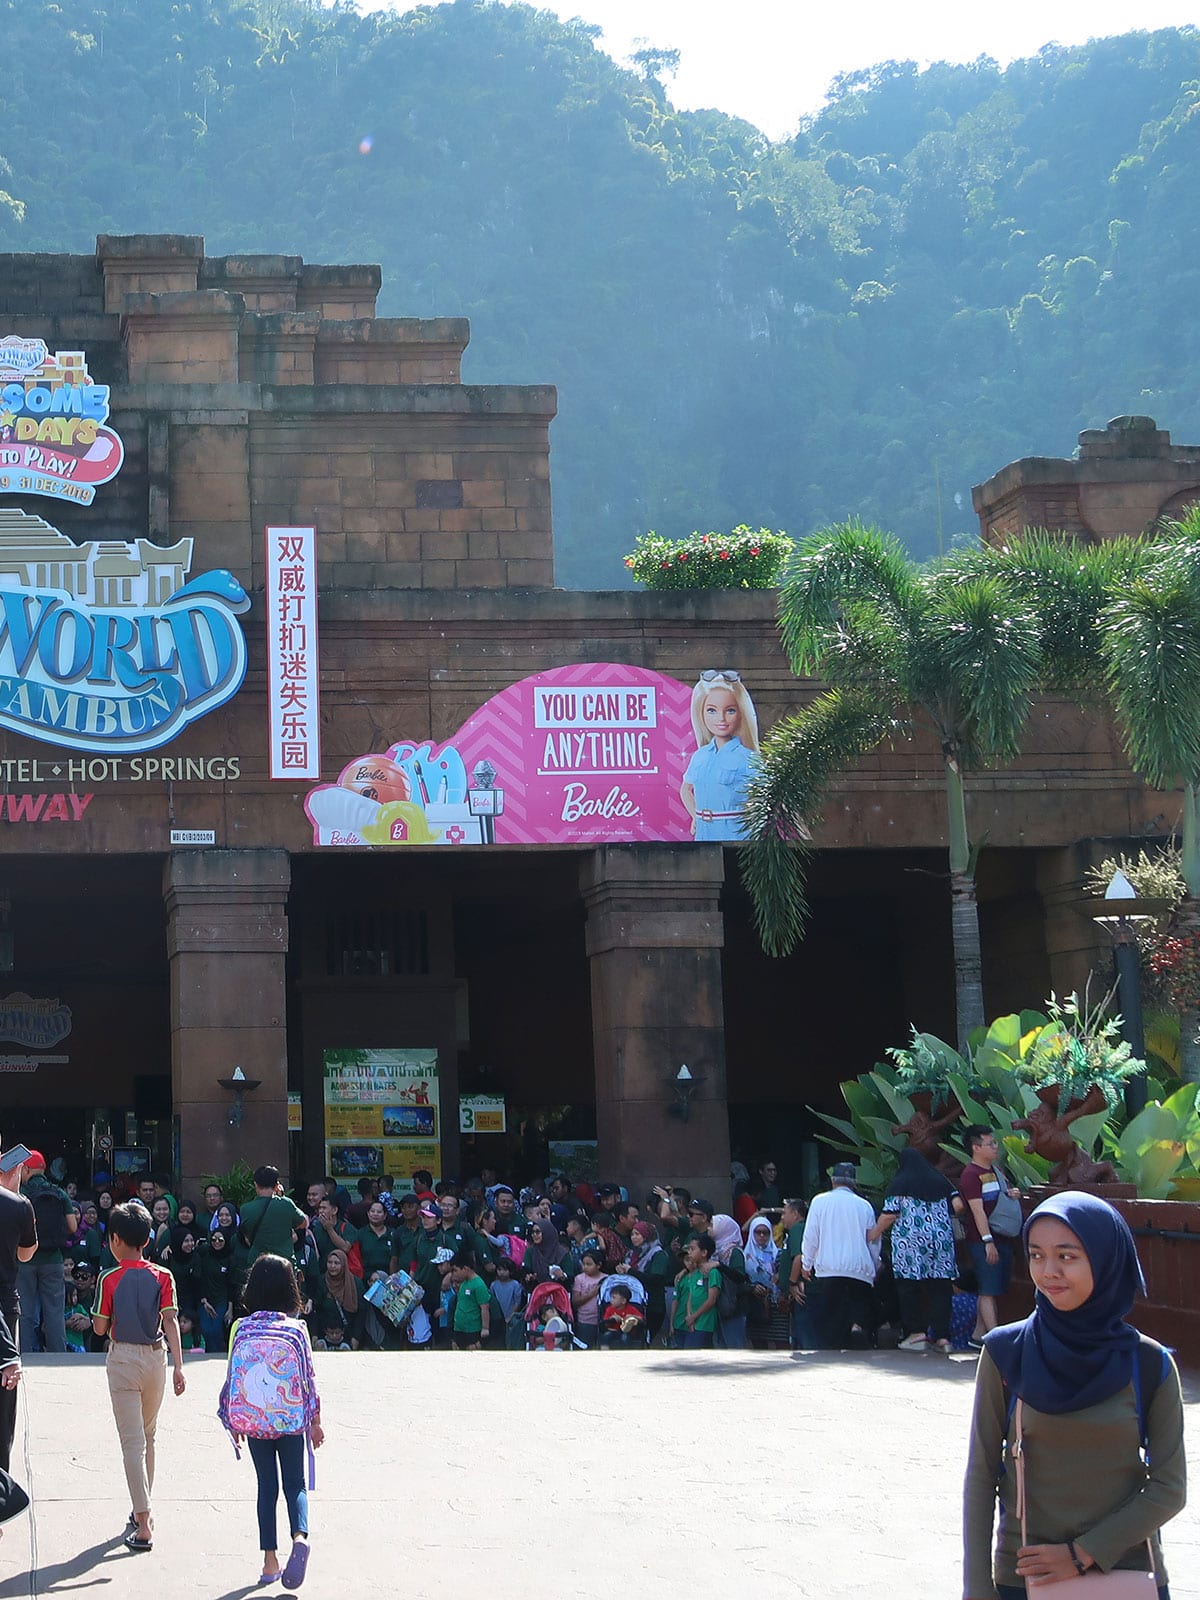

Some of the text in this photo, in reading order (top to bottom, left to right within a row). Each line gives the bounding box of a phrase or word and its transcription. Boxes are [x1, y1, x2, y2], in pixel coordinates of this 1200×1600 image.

[0, 449, 20, 465] TO
[24, 446, 78, 478] PLAY!
[18, 477, 32, 489] 31
[35, 479, 59, 493] DEC
[62, 483, 91, 501] 2019
[277, 535, 308, 770] 双威打扪迷失乐园
[541, 693, 648, 721] YOU CAN BE
[543, 731, 651, 769] ANYTHING
[68, 758, 122, 782] HOT
[130, 757, 241, 781] SPRINGS
[356, 766, 388, 783] Barbie
[560, 782, 640, 823] Barbie
[330, 830, 361, 845] Barbie
[0, 1063, 38, 1072] SUNWAY
[462, 1108, 473, 1128] 3
